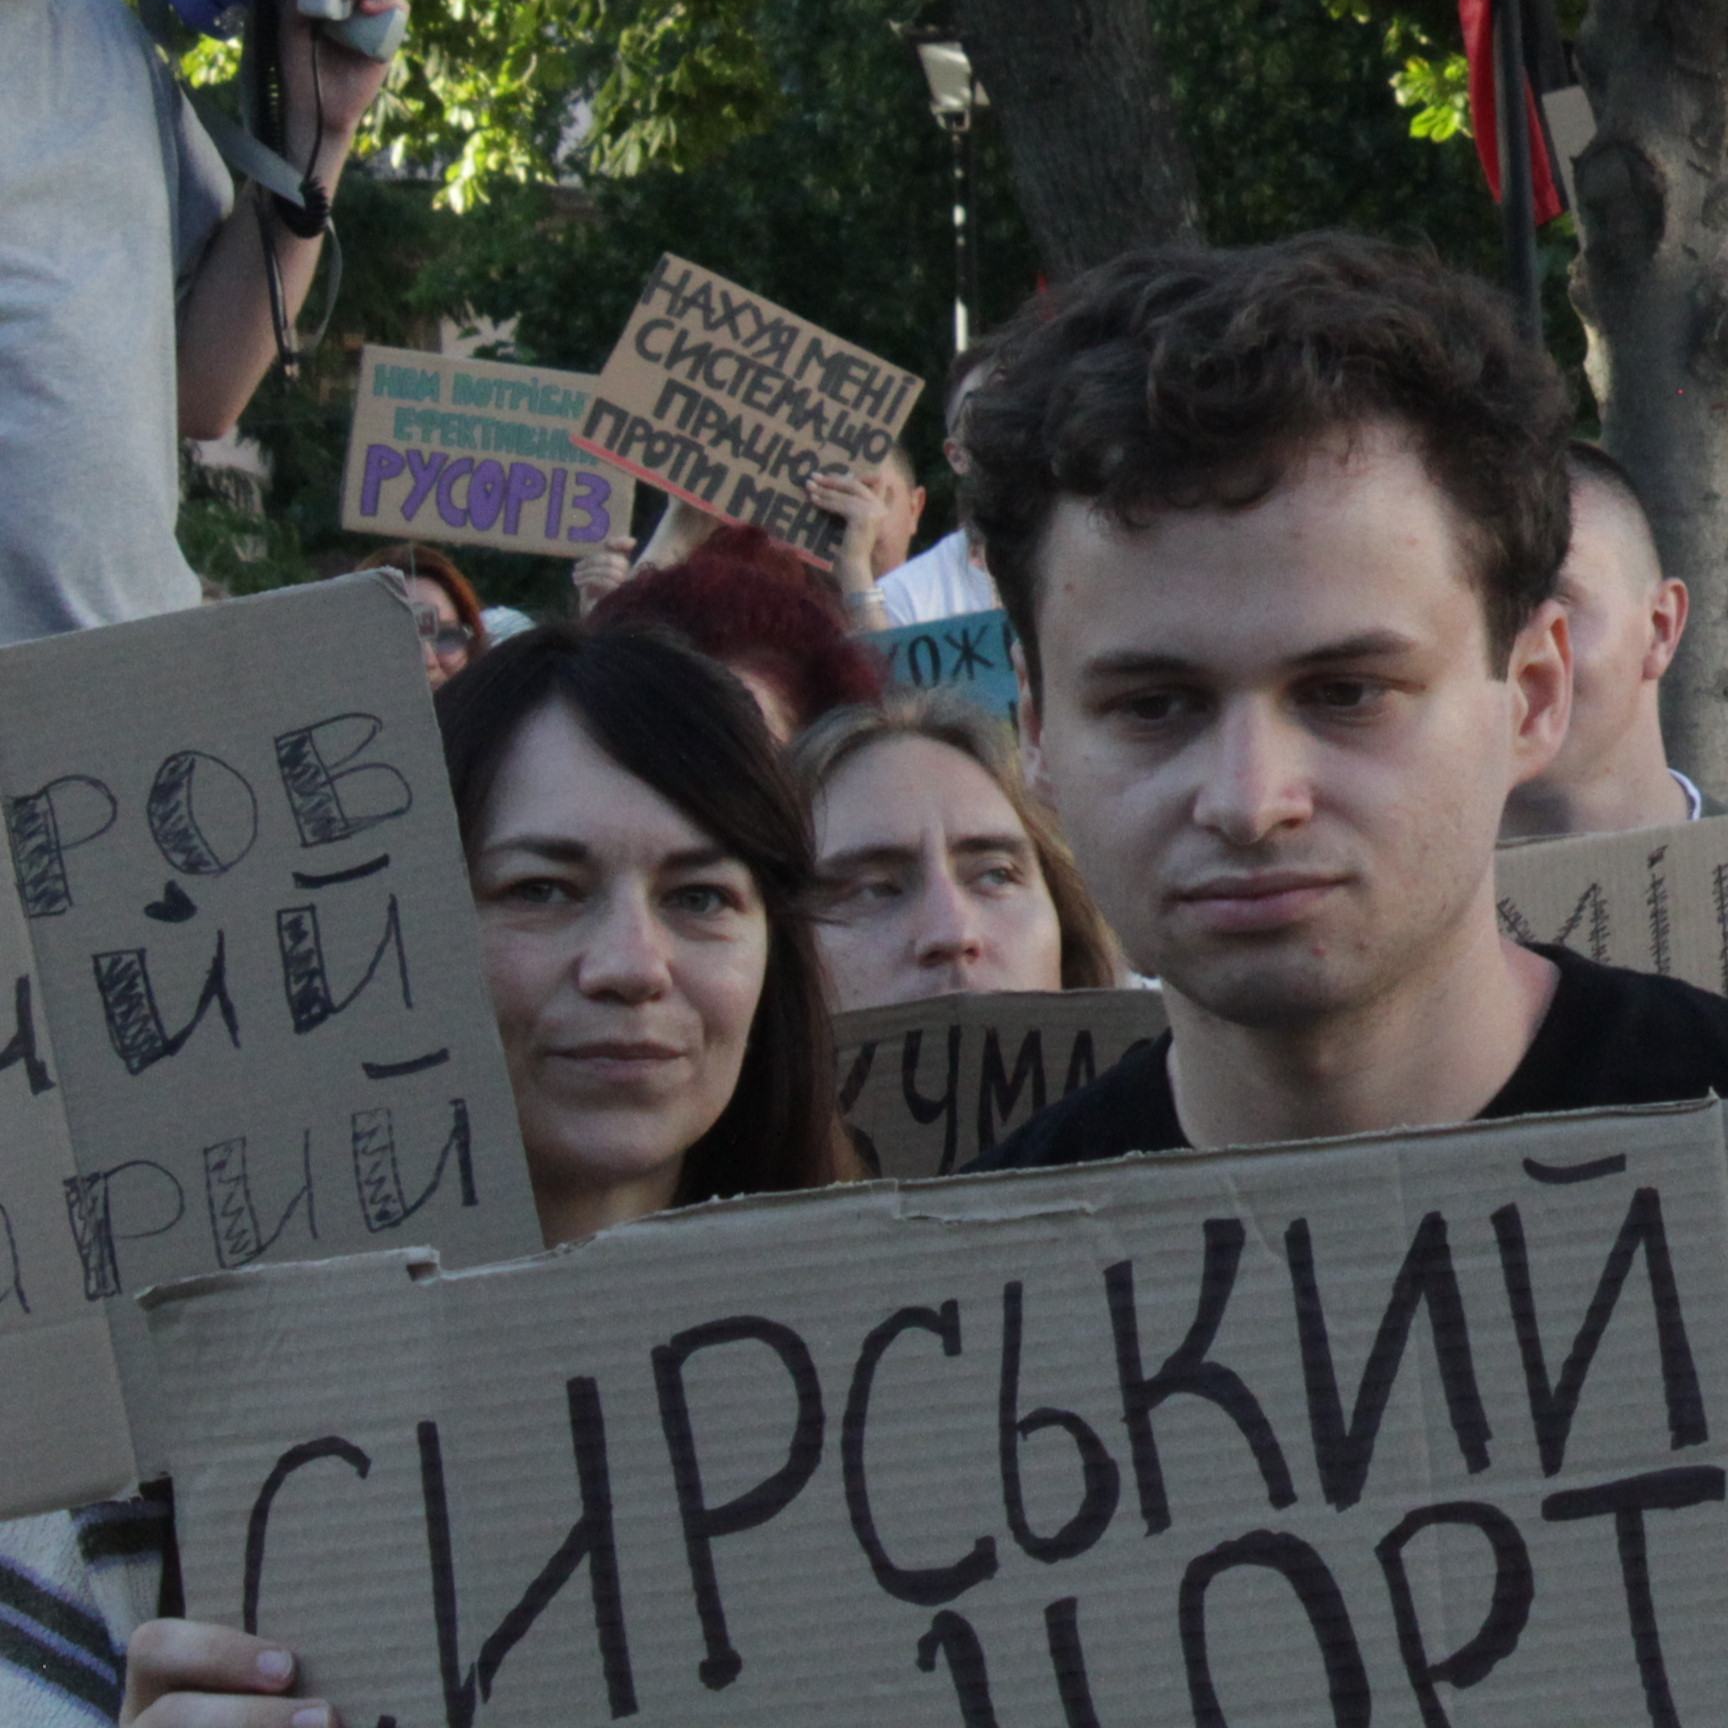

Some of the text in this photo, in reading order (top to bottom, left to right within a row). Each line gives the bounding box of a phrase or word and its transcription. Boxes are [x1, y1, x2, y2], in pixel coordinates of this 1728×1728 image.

[640, 256, 917, 427] НАХУЯ МЕНІ
[360, 443, 613, 544] РУСОРІЗ
[583, 397, 731, 503] ПРОТИ
[242, 1152, 1712, 1728] СИРСЬКИЙ
